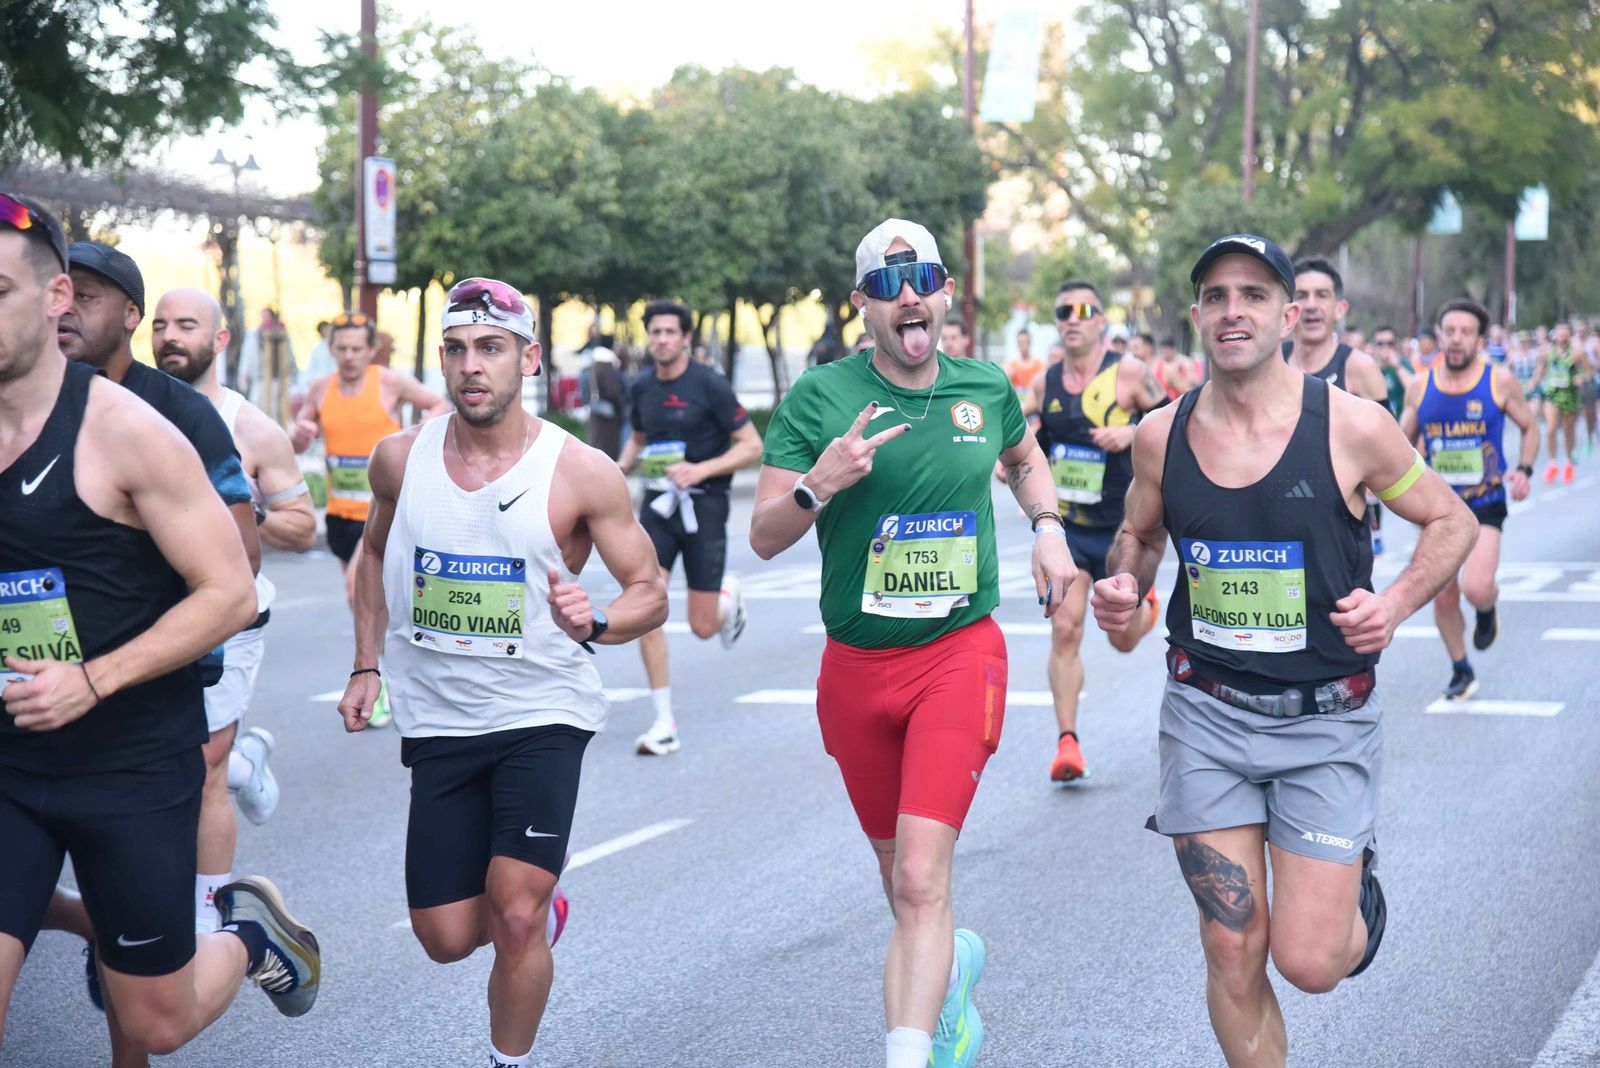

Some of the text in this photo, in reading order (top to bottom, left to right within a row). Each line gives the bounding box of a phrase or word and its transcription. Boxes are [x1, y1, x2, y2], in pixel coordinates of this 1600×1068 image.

[1445, 420, 1487, 437] LANKA
[1067, 447, 1100, 460] ZURICH
[904, 518, 964, 534] ZURICH
[904, 550, 939, 565] 1753
[1217, 549, 1287, 563] ZURICH
[447, 561, 511, 576] ZURICH
[0, 577, 46, 597] RICH
[884, 570, 961, 593] DANIEL
[1221, 581, 1259, 595] 2143
[448, 590, 482, 605] 2524
[413, 607, 522, 635] DIOGO VIANA
[1192, 603, 1305, 628] ALFONSO Y LOLA
[1, 617, 21, 634] 49
[1315, 832, 1354, 850] TERREX
